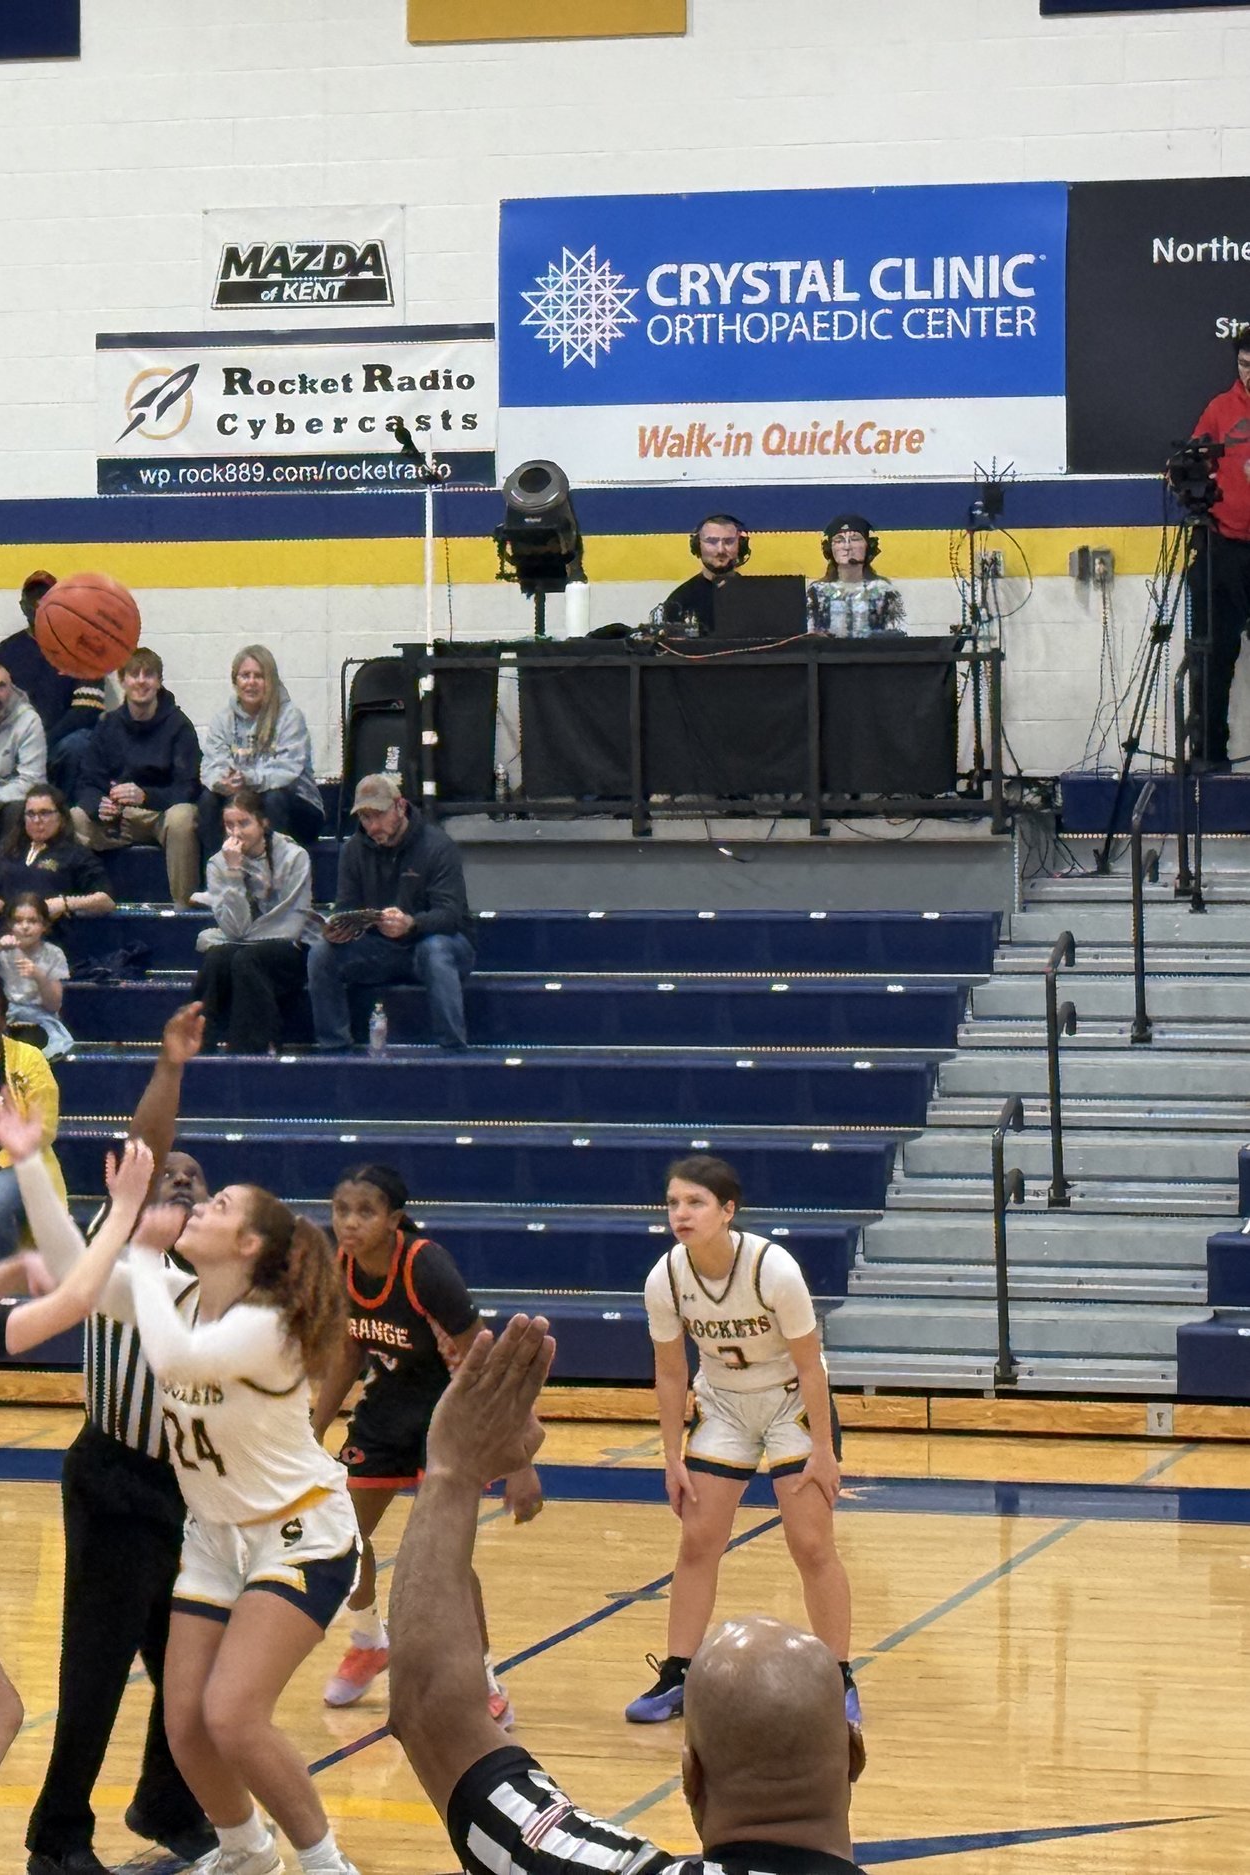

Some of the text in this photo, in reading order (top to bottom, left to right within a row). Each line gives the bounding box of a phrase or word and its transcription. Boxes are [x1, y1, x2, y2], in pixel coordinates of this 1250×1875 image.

[221, 243, 384, 280] MAZDA
[646, 253, 1036, 306] CRYSTAL CLINIC
[261, 281, 346, 301] of KENT
[646, 305, 1037, 345] ORTHOPAEDIC CENTER
[222, 363, 476, 396] Rocket Radio
[216, 409, 480, 440] Cybercasts
[638, 420, 925, 458] Walk-in QuickCare
[161, 1406, 227, 1477] 24
